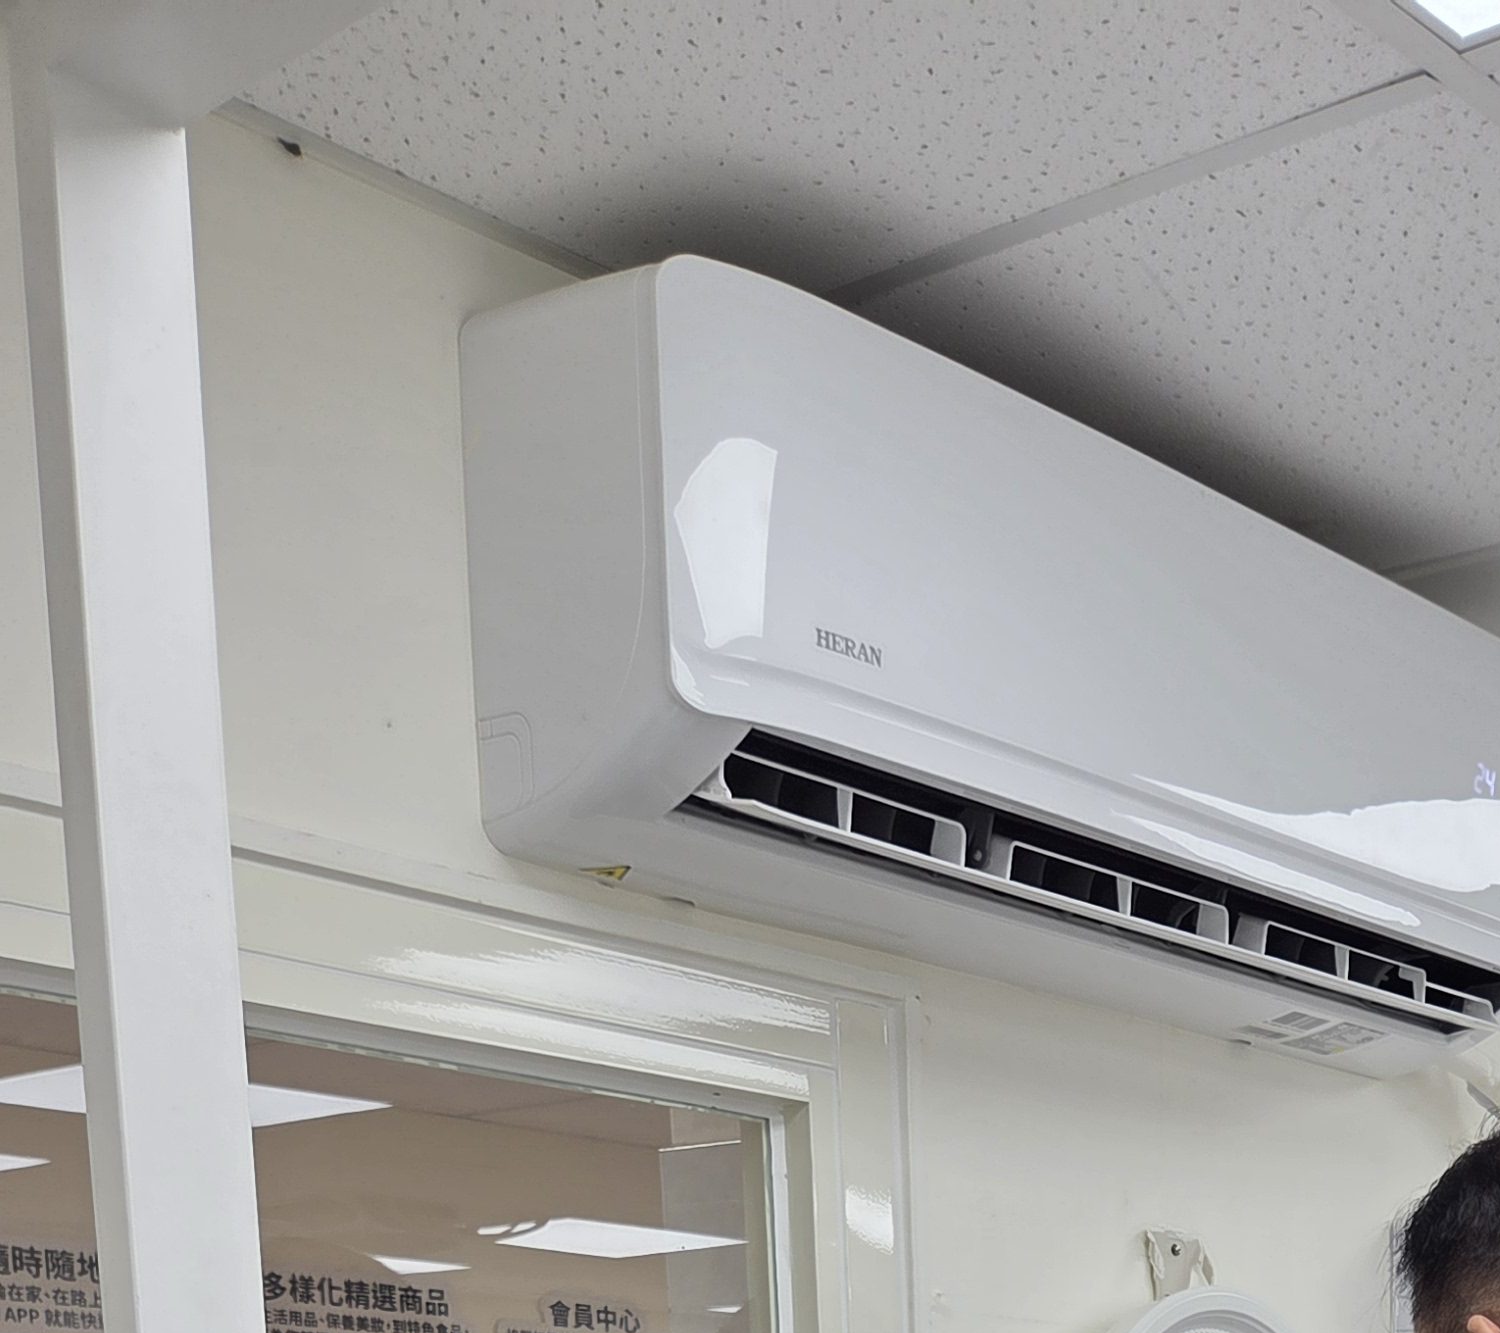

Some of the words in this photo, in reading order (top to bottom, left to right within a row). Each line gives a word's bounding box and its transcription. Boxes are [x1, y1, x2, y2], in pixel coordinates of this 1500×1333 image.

[816, 627, 882, 668] HERAN
[263, 1272, 449, 1317] 多樣化精選商品
[5, 1307, 39, 1325] APP
[45, 1310, 103, 1330] 就能快
[549, 1300, 641, 1333] 會員中心
